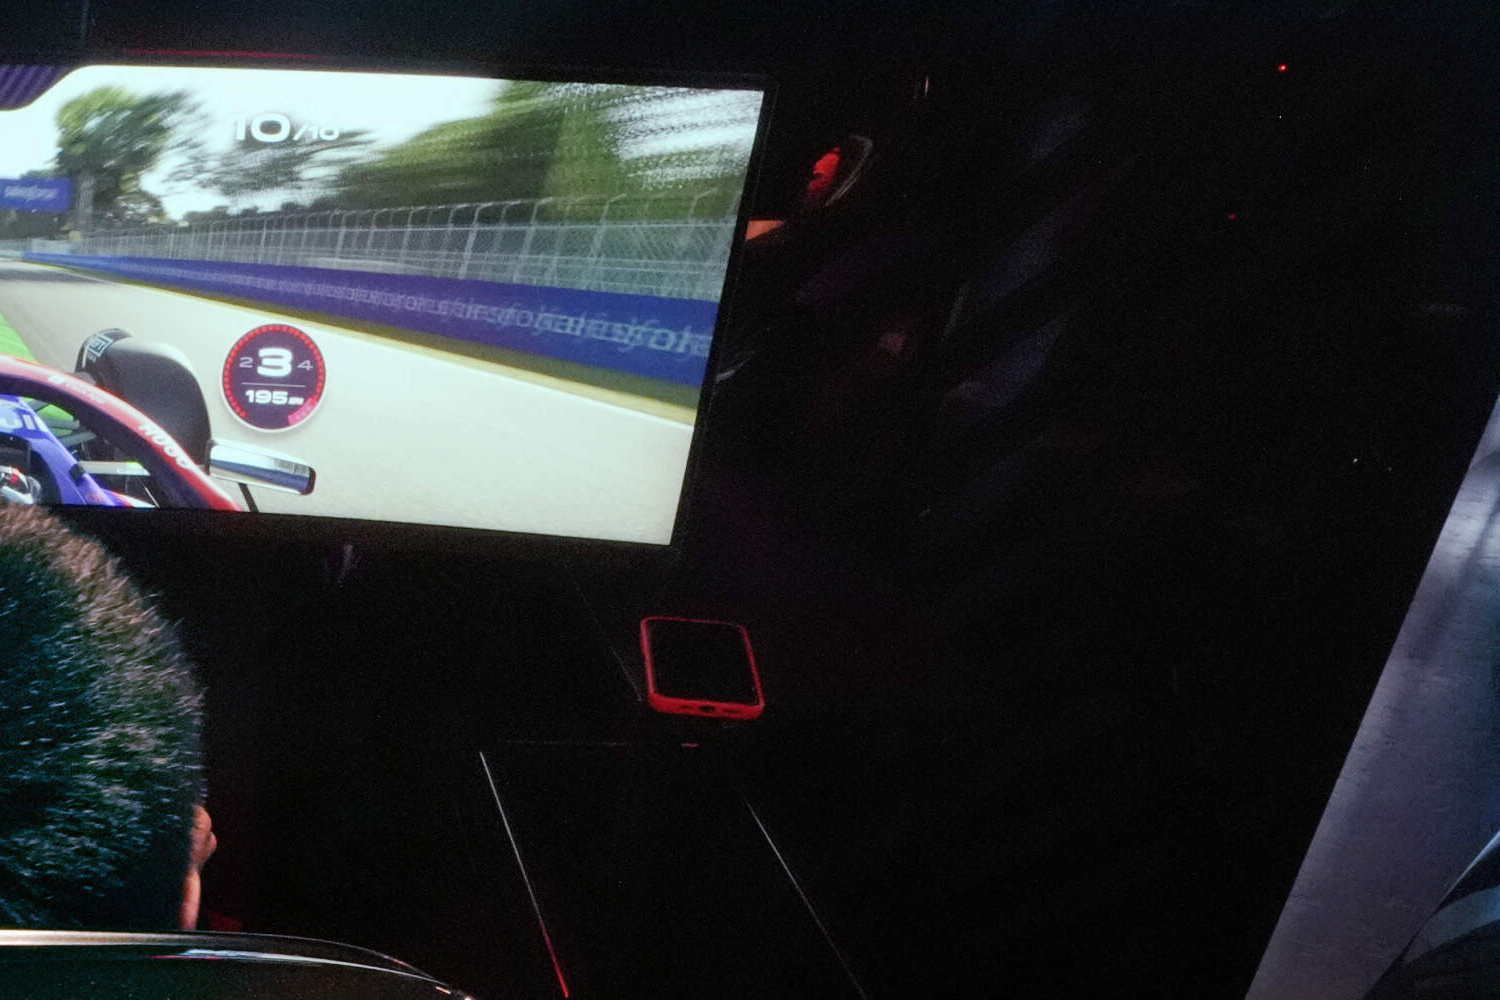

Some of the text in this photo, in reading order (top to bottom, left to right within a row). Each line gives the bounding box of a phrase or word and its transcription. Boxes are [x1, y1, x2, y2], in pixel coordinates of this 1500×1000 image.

[239, 348, 313, 377] 2 3 4
[245, 389, 288, 405] 195
